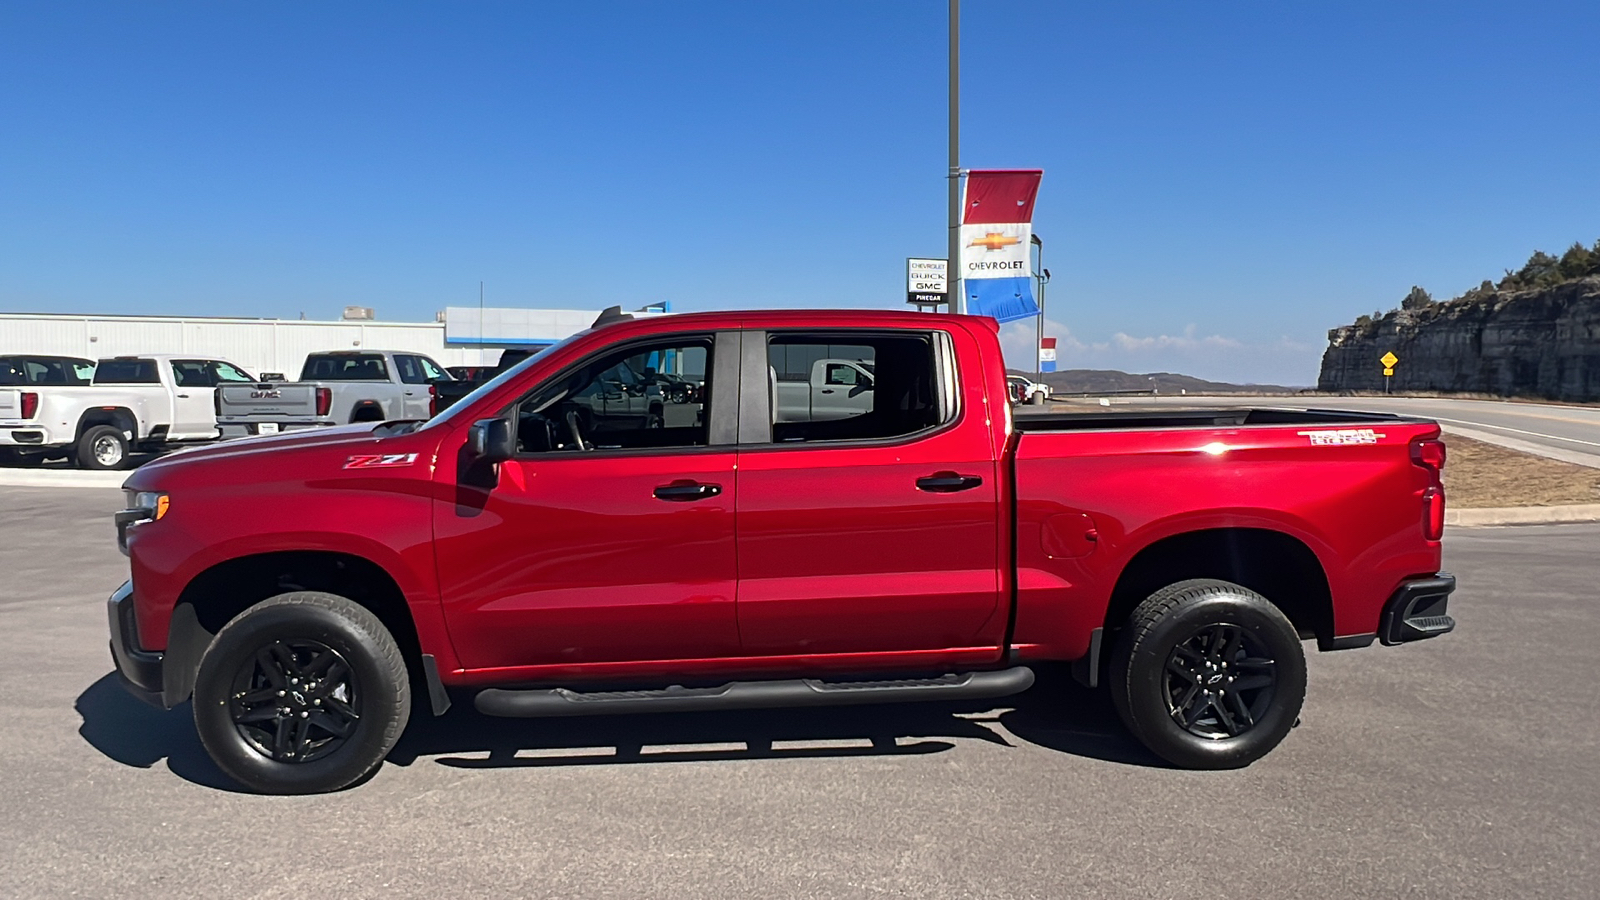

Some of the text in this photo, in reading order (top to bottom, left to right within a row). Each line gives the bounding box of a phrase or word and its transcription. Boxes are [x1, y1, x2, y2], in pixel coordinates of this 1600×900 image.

[968, 260, 1024, 271] CHEVROLET
[911, 272, 945, 280] BUICK
[915, 282, 941, 290] GMC
[342, 452, 420, 470] Z71
